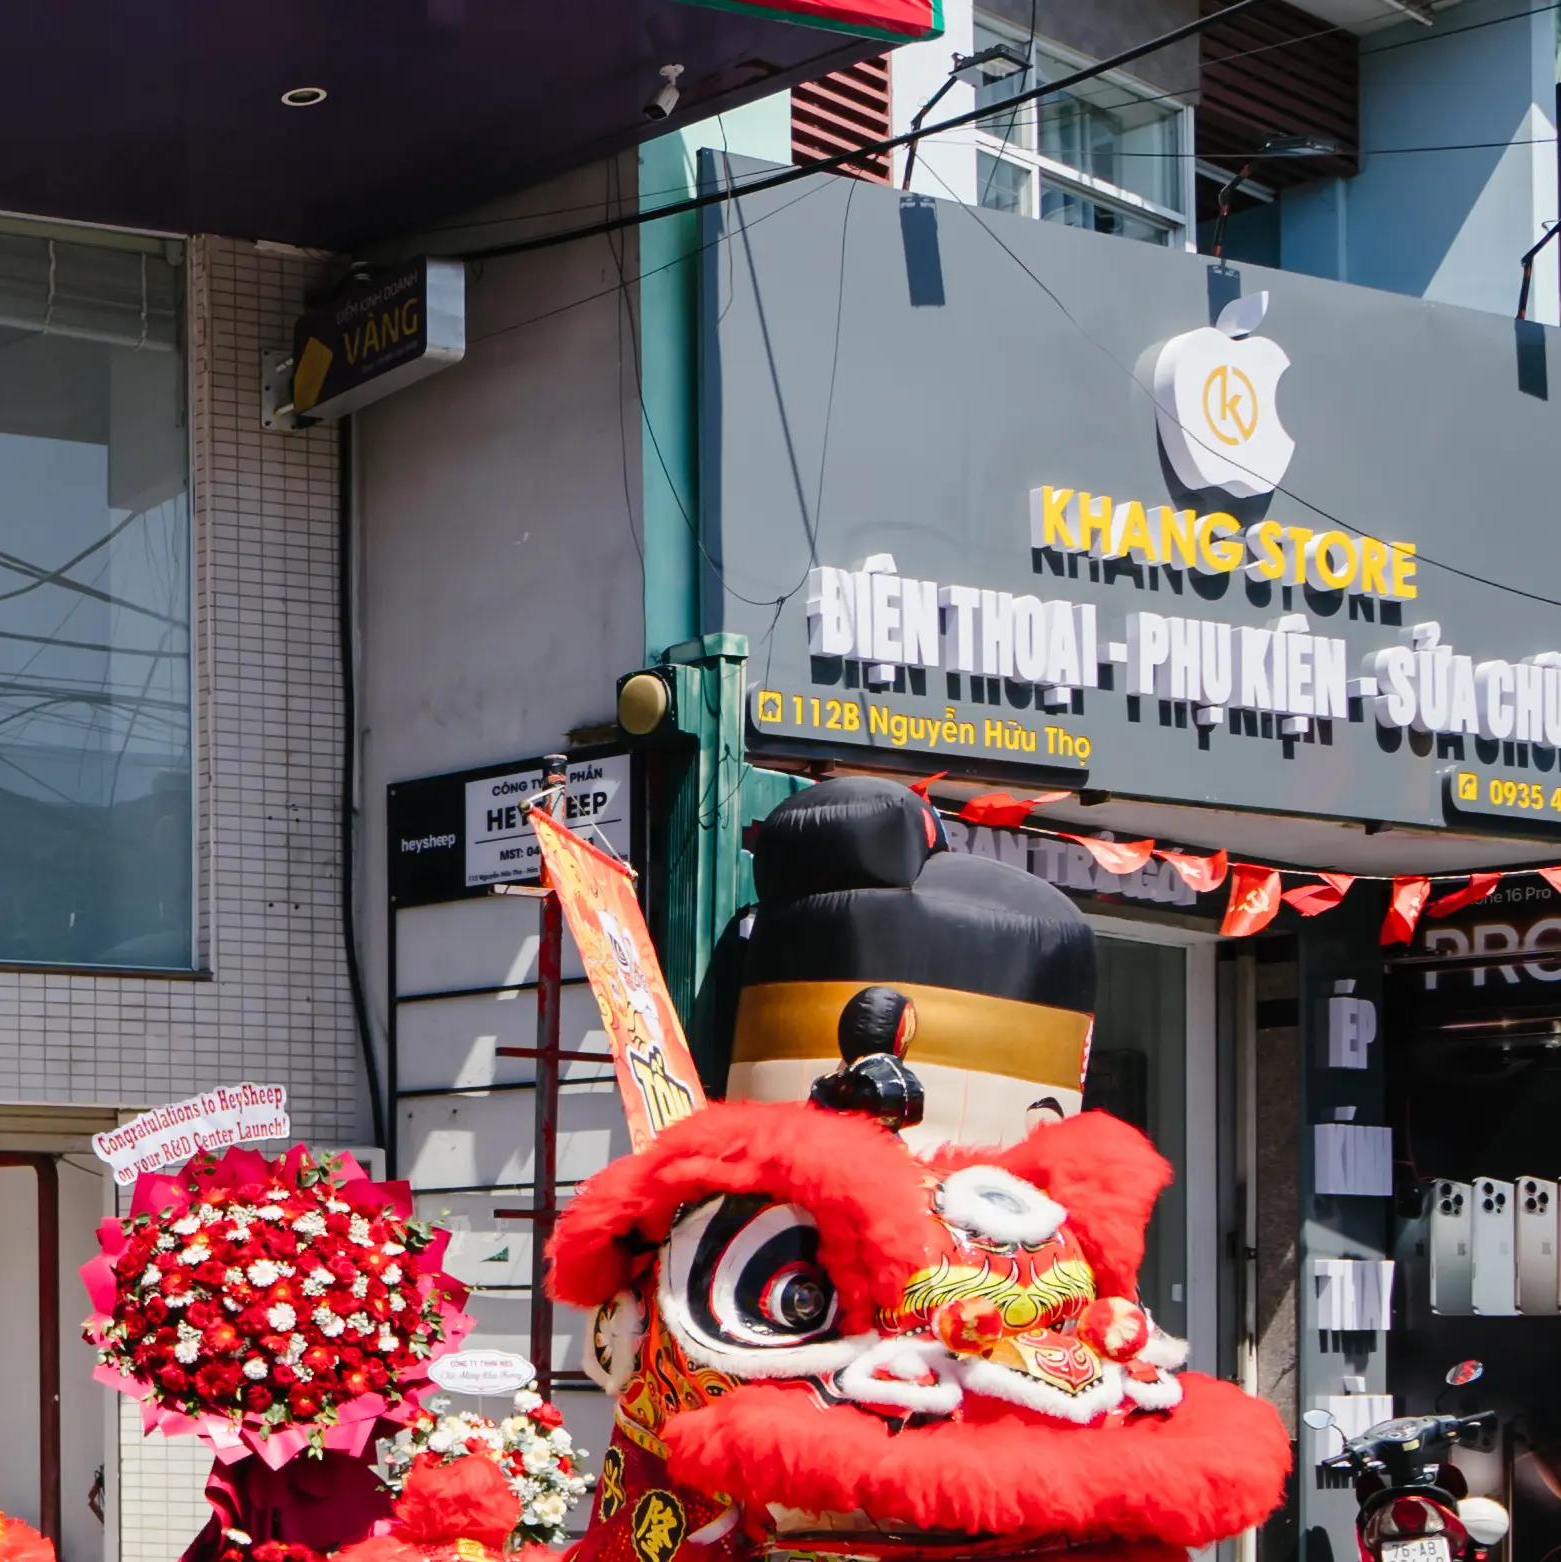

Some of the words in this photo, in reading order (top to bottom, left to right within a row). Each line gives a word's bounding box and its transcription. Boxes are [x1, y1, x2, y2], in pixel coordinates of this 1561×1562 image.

[343, 298, 418, 365] VÀNG
[1035, 485, 1244, 572] KHANG
[1251, 519, 1418, 599] STORE
[809, 553, 939, 683] ĐIỆN
[941, 585, 1098, 704] THOẠI
[1127, 612, 1232, 725] PHỤ
[1231, 614, 1347, 735] KIỆN
[1375, 621, 1478, 733] SỬA
[791, 696, 861, 731] 112B
[870, 705, 975, 747] Nguyễn
[984, 718, 1036, 751] Hữu
[1045, 726, 1092, 766] Thọ
[492, 781, 527, 797] CÔNG
[569, 764, 603, 783] PHẦN
[1489, 778, 1544, 810] 0935
[401, 833, 456, 854] heysheep
[1505, 887, 1522, 902] 16
[1525, 887, 1552, 900] Pro
[97, 1103, 201, 1156] Congratulations
[200, 1095, 215, 1116] to
[216, 1084, 283, 1113] HeySheep
[117, 1166, 135, 1183] on
[133, 1152, 161, 1173] your
[161, 1136, 192, 1161] R&D
[193, 1128, 234, 1150] Center
[236, 1117, 287, 1140] Launch!
[1391, 1541, 1437, 1558] 76-AB
